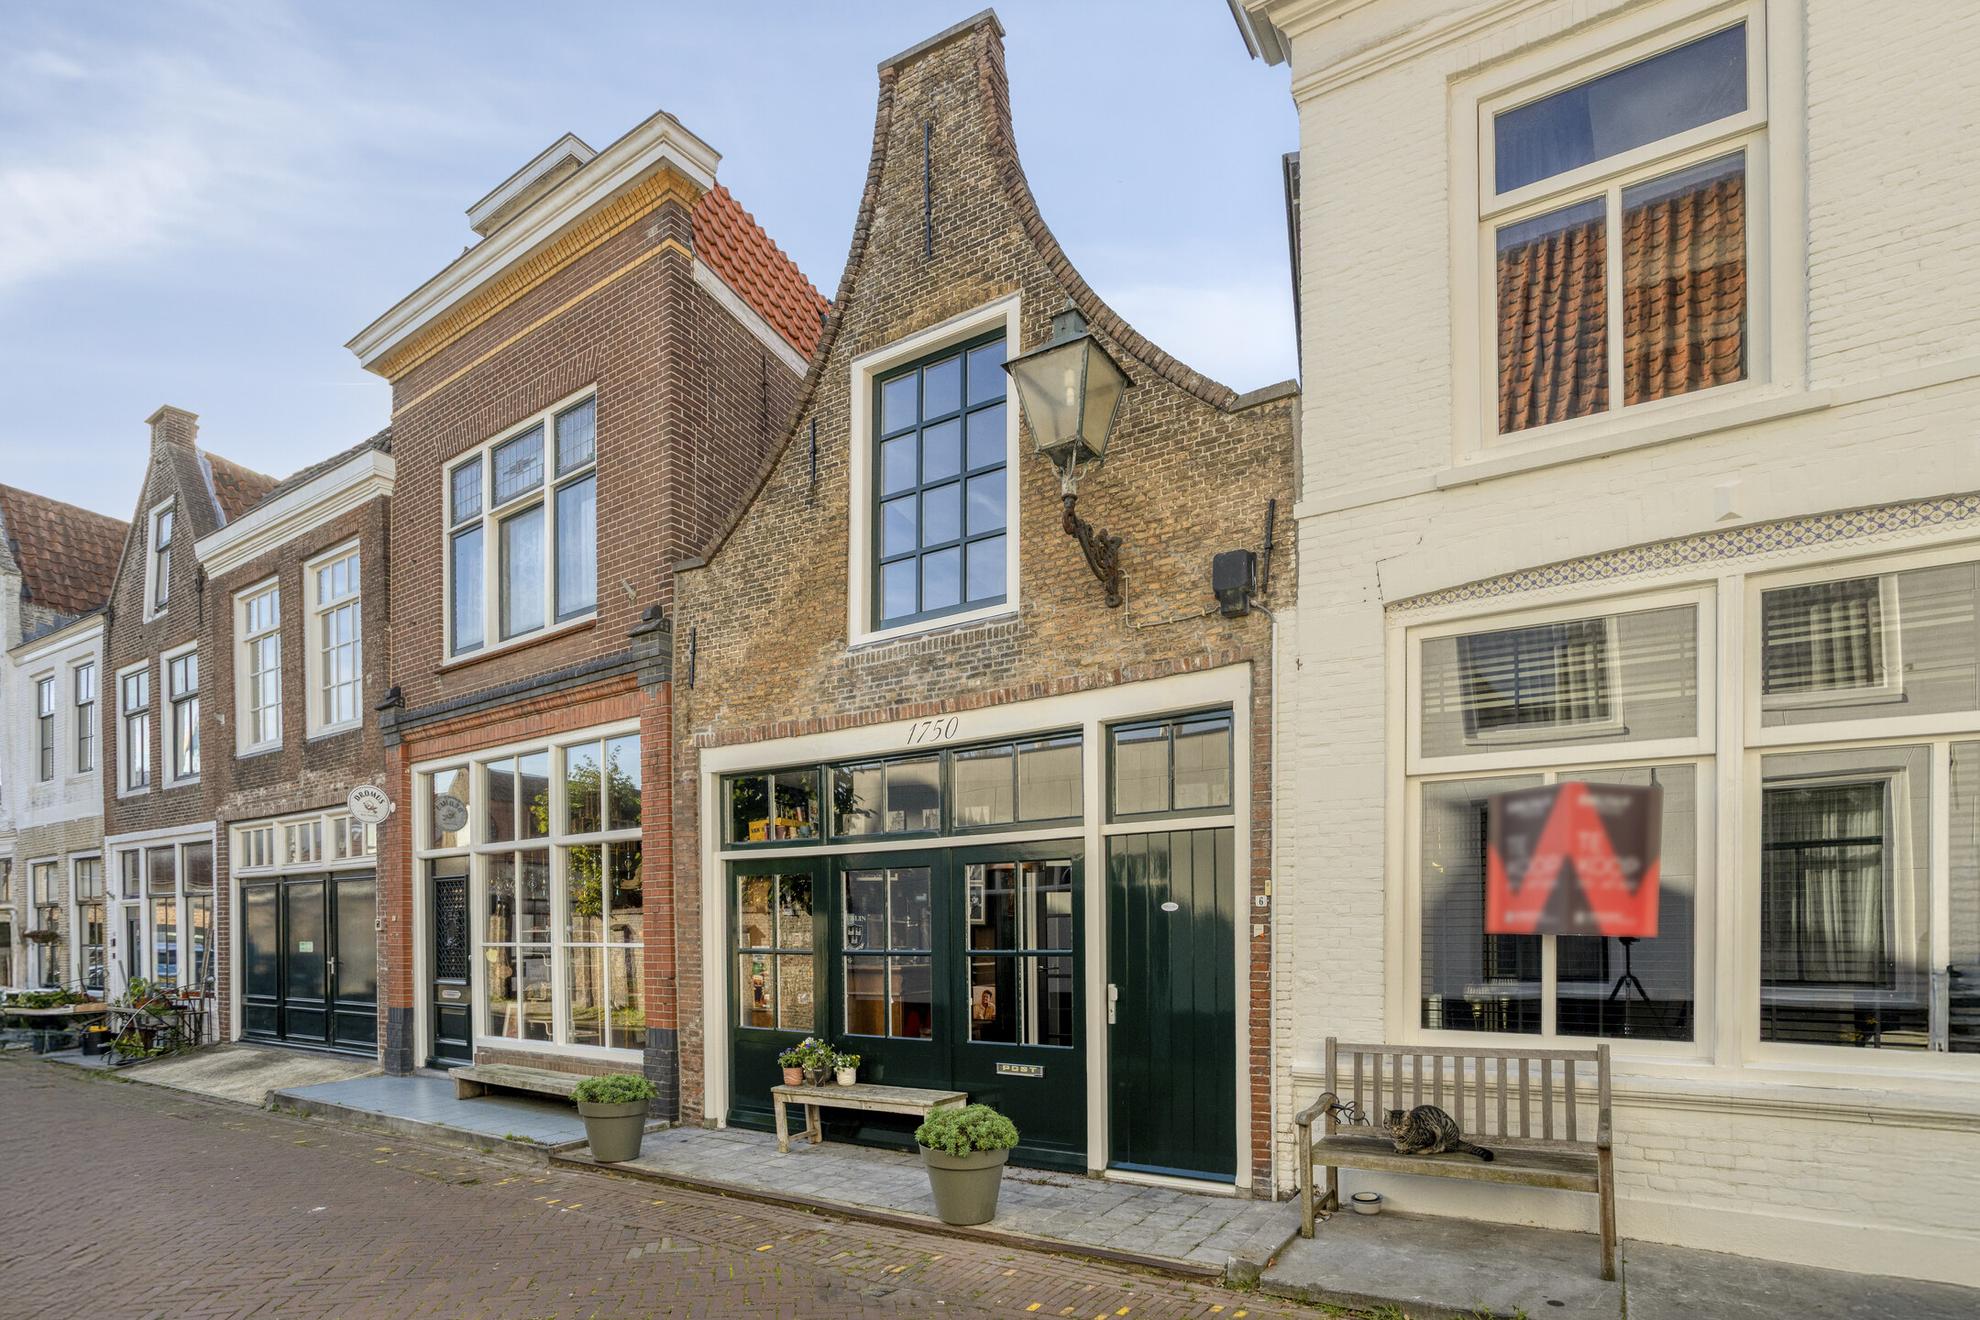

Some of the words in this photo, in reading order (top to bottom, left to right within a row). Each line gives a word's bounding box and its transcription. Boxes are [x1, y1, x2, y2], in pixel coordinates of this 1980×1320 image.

[907, 716, 959, 745] 1750
[1258, 896, 1264, 906] 6
[1002, 1065, 1038, 1073] POST
